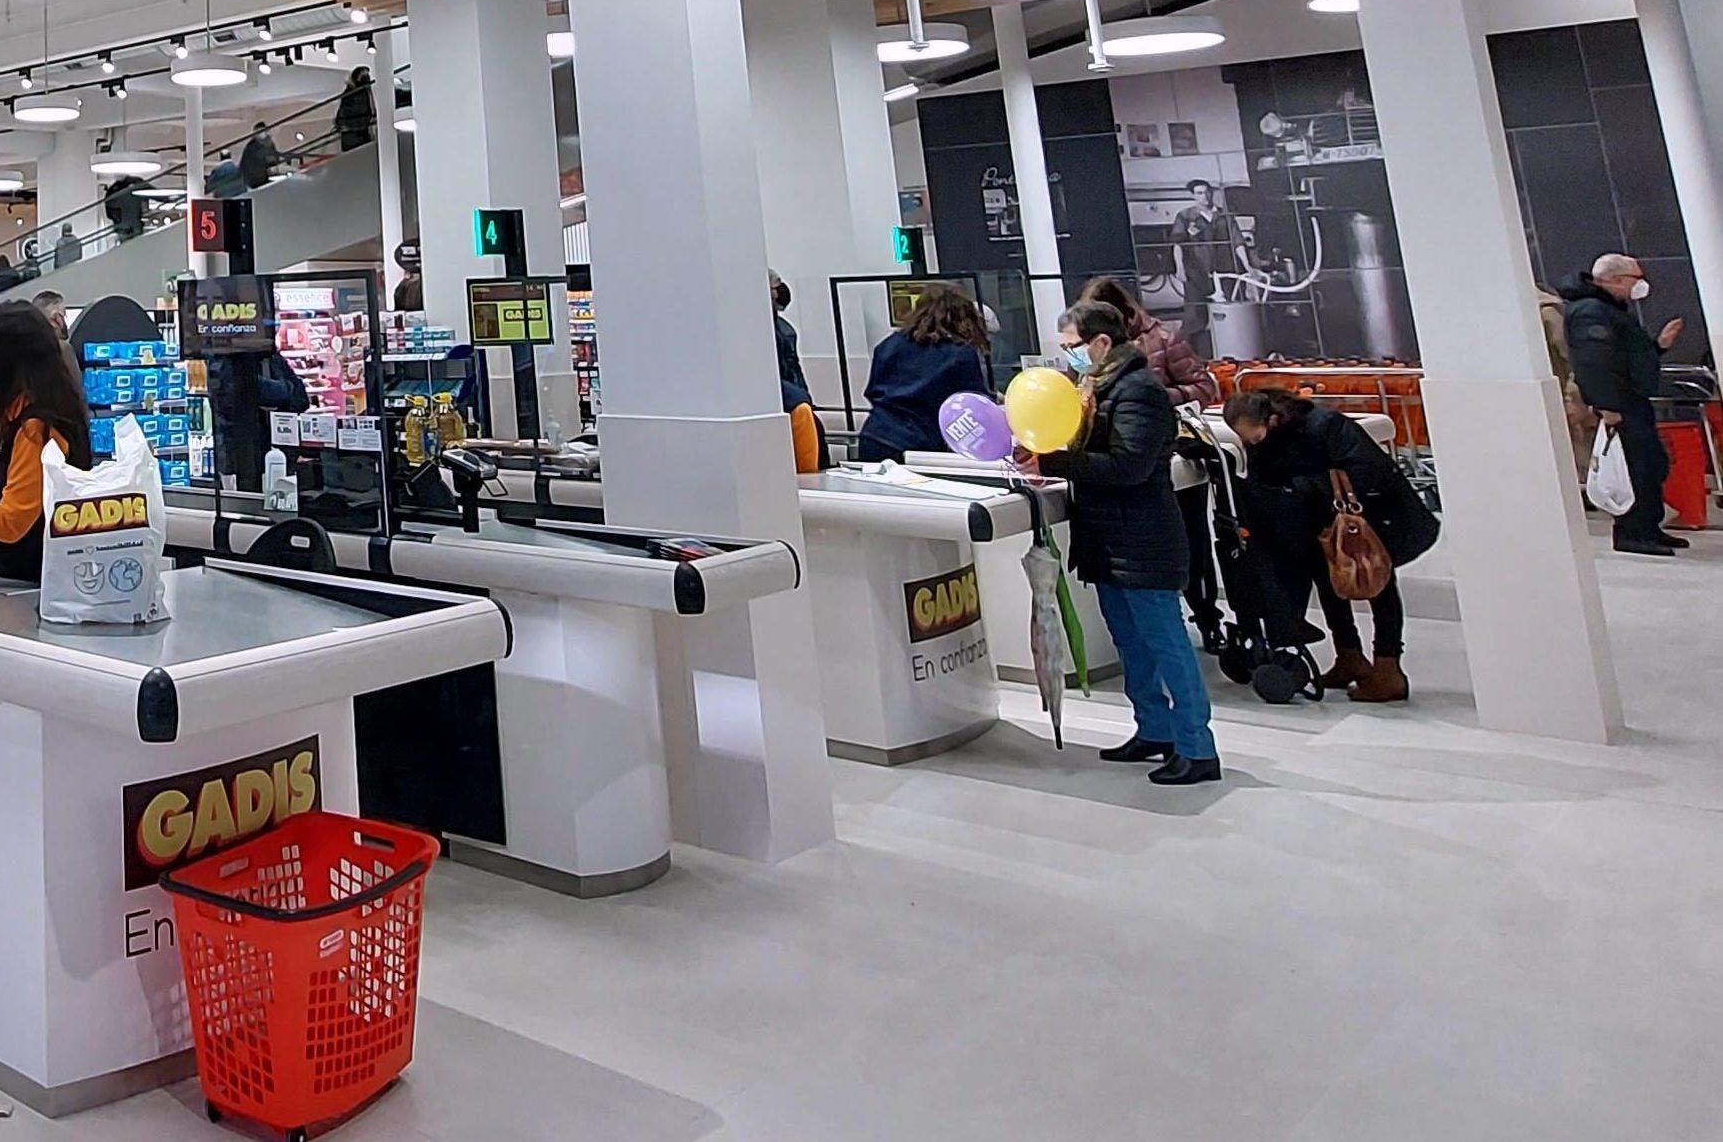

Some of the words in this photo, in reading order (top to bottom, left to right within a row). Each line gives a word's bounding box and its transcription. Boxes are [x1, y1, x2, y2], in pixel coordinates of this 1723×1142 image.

[200, 211, 217, 240] 5
[485, 220, 497, 245] 4
[900, 234, 910, 254] 2
[211, 324, 257, 334] confianza
[53, 496, 147, 532] GADIS
[913, 571, 978, 628] GADIS
[912, 654, 937, 682] En
[139, 751, 316, 863] GADIS
[125, 908, 175, 959] En
